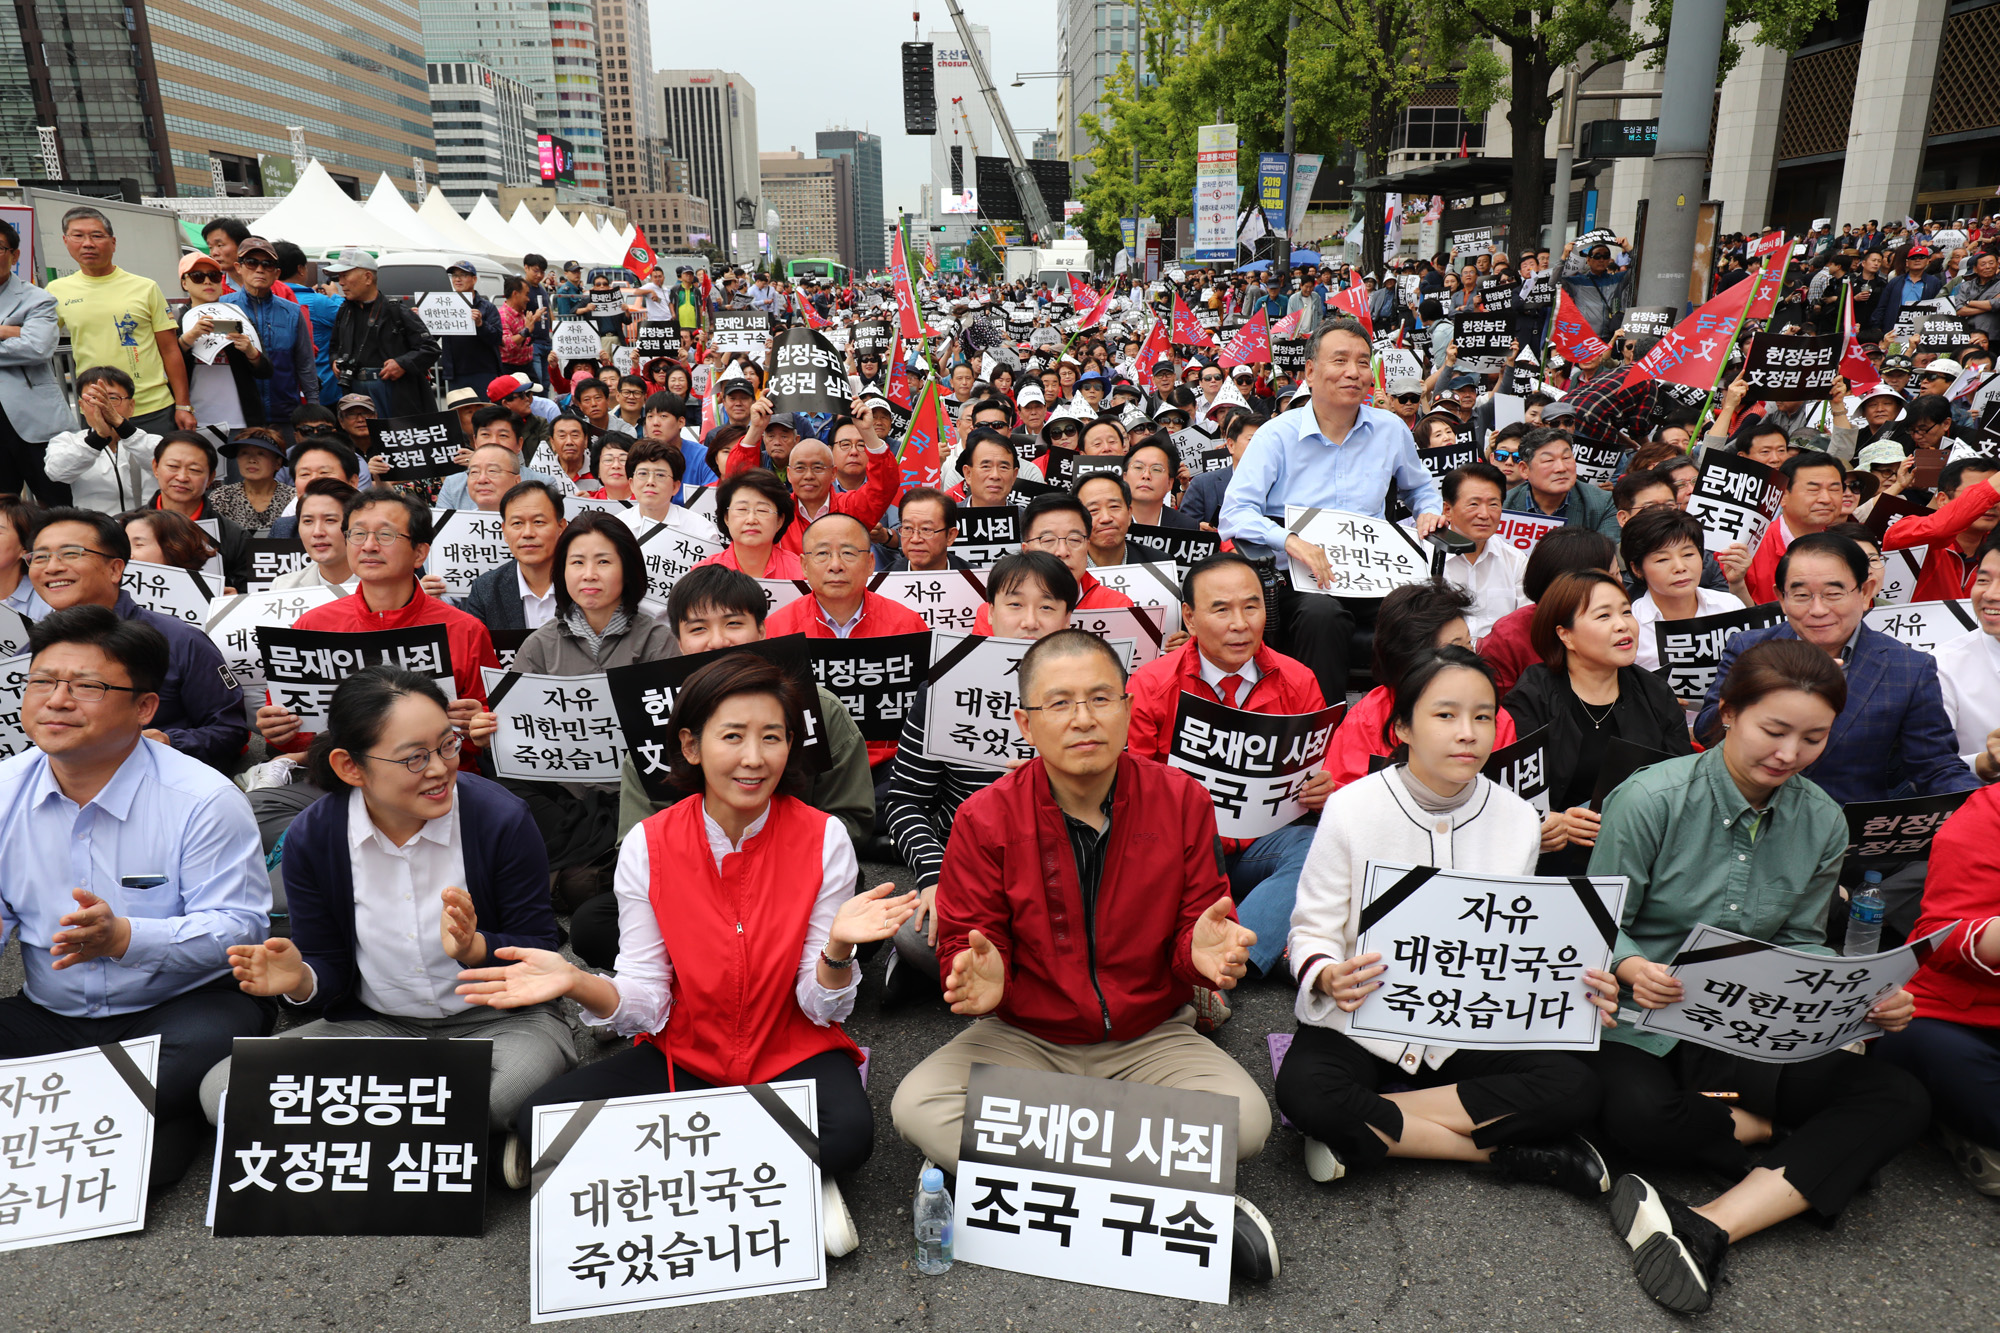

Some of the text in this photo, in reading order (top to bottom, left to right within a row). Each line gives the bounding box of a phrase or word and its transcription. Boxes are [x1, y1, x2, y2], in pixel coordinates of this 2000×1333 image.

[936, 50, 983, 60] 조선일
[1263, 176, 1281, 186] 2019
[1263, 188, 1280, 198] 실패
[1454, 230, 1490, 244] 문재인 사죄
[1456, 245, 1472, 253] 조국
[435, 296, 452, 307] 자유
[1439, 290, 1450, 299] 사죄
[1485, 288, 1512, 301] 헌정농단
[424, 308, 467, 318] 대한민국은
[715, 316, 767, 330] 문재인 사죄
[1174, 311, 1190, 320] 조국
[1631, 312, 1668, 323] 헌정농단
[567, 325, 583, 334] 자유
[639, 327, 674, 338] 헌정농단
[855, 326, 884, 338] 헌정농단
[1158, 328, 1166, 339] 文
[1176, 321, 1185, 332] 文
[1462, 320, 1507, 333] 헌정농단
[1557, 320, 1582, 335] 조국
[1623, 323, 1650, 333] 文정권
[1923, 321, 1963, 332] 헌정농단
[557, 334, 596, 344] 대한민국은
[663, 339, 681, 350] 심판
[717, 333, 766, 345] 조국 구속
[875, 338, 889, 348] 심판
[1272, 344, 1304, 354] 헌정농단
[1455, 335, 1513, 348] 文정권 심판
[1951, 334, 1971, 345] 심판
[558, 345, 597, 354] 죽었습니다
[777, 344, 843, 374] 헌정농단
[1386, 353, 1404, 364] 자유
[1766, 347, 1832, 366] 헌정농단
[1848, 345, 1866, 361] 文
[766, 372, 816, 398] 文정권
[1749, 369, 1838, 388] 文정권 심판
[889, 380, 902, 398] 文
[380, 424, 448, 448] 헌정농단
[380, 448, 426, 470] 文정권
[1443, 451, 1474, 470] 사죄
[1595, 447, 1621, 467] 사죄
[1701, 465, 1782, 516] 문재인 사죄
[974, 517, 1014, 542] 사죄
[1692, 502, 1744, 540] 조국
[1337, 520, 1380, 545] 자유
[444, 544, 514, 564] 대한민국
[673, 540, 706, 561] 자유
[1174, 540, 1215, 563] 사죄
[122, 571, 170, 599] 자유
[904, 581, 946, 603] 자유
[263, 597, 310, 620] 자유
[920, 606, 976, 629] 민국은
[1881, 613, 1927, 637] 자유
[269, 645, 365, 680] 문재인
[810, 654, 914, 687] 헌정농단
[542, 687, 599, 714] 자유
[512, 714, 626, 742] 대한민국
[950, 722, 1037, 758] 죽었습
[1179, 716, 1334, 772] 문재인 사죄
[1458, 892, 1539, 935] 자유
[1393, 935, 1583, 983] 대한민국은
[1784, 968, 1872, 994] 자유
[1383, 983, 1574, 1030] 죽었습니다
[0, 1072, 72, 1118] 자유
[268, 1074, 452, 1126] 헌정농단
[1, 1114, 122, 1169] 민국은
[634, 1111, 721, 1161] 자유
[973, 1095, 1224, 1184] 문재인 사죄
[229, 1141, 478, 1194] 文정권 심판
[570, 1162, 786, 1228] 대한민국은
[966, 1176, 1218, 1268] 조국 구속
[568, 1219, 790, 1290] 죽었습니다
